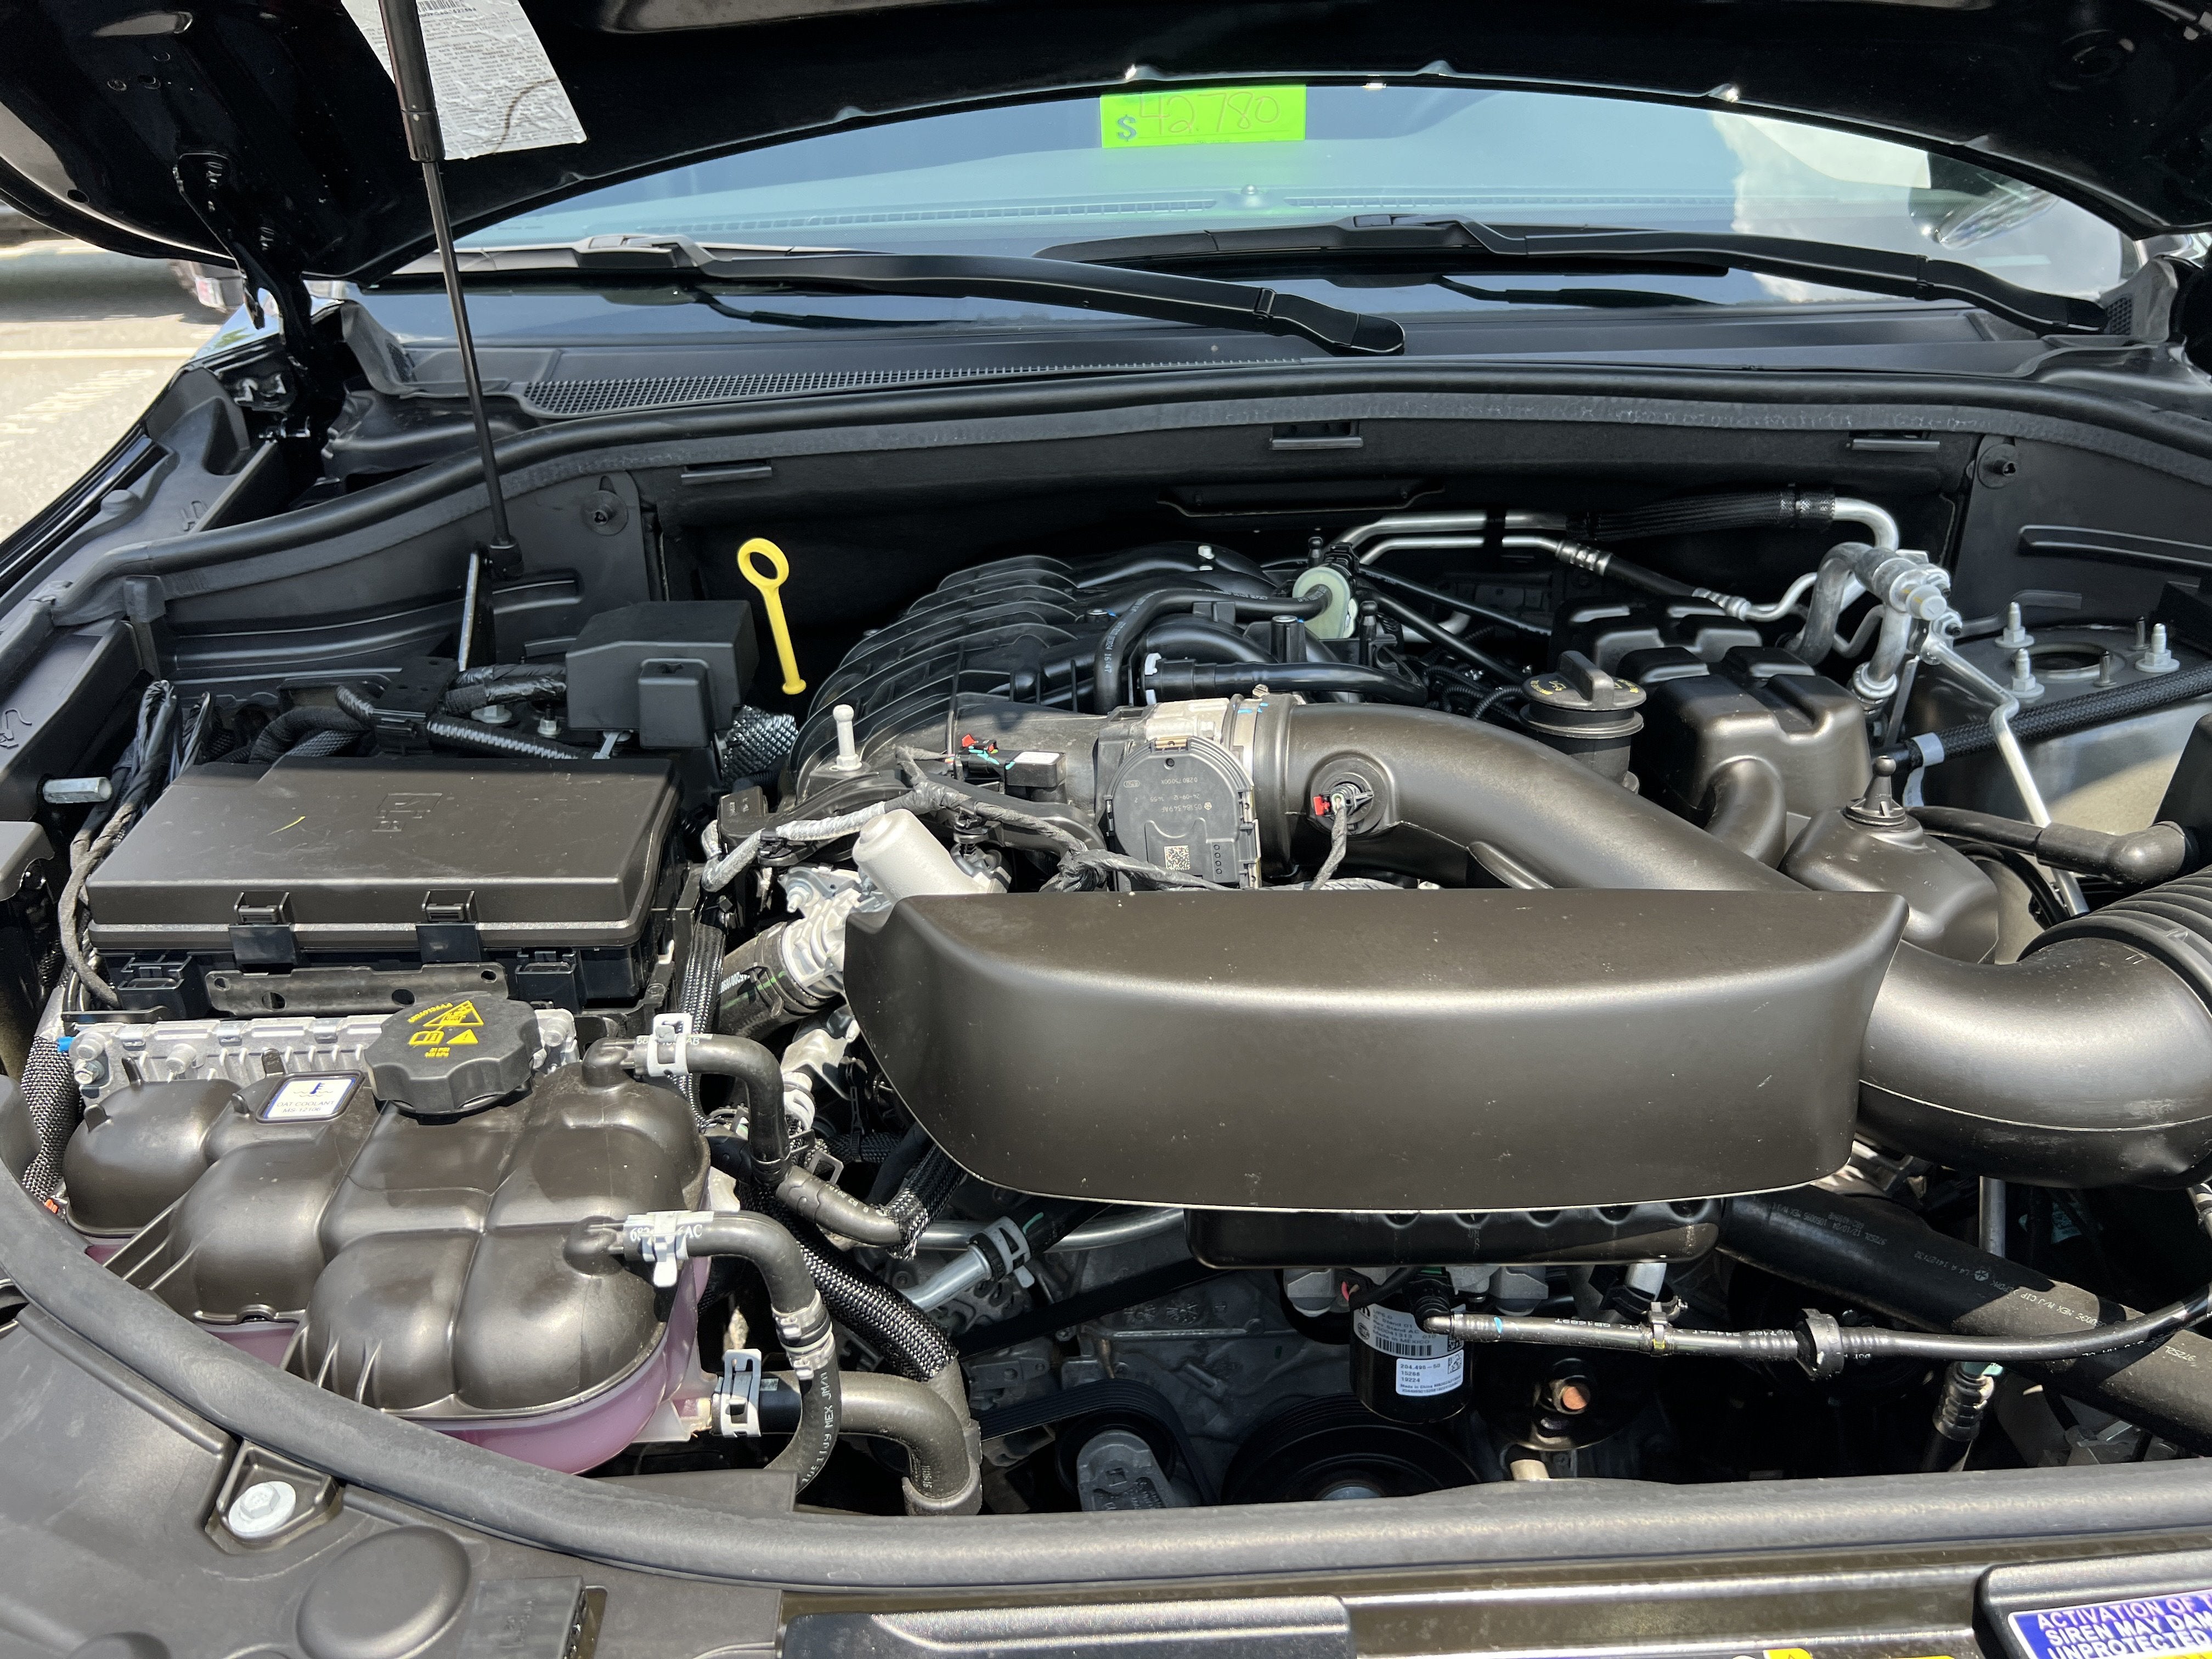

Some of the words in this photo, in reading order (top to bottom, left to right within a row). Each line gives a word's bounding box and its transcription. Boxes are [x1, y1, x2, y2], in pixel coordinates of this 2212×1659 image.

[1117, 114, 1137, 142] $
[1373, 1329, 1389, 1339] Made
[824, 1404, 834, 1428] MEX
[2037, 1600, 2166, 1630] ACTIVATION
[2165, 1596, 2196, 1614] OF
[2045, 1623, 2115, 1646] SIREN
[2114, 1617, 2164, 1638] MAY
[2047, 1629, 2212, 1659] UNPROTECTED
